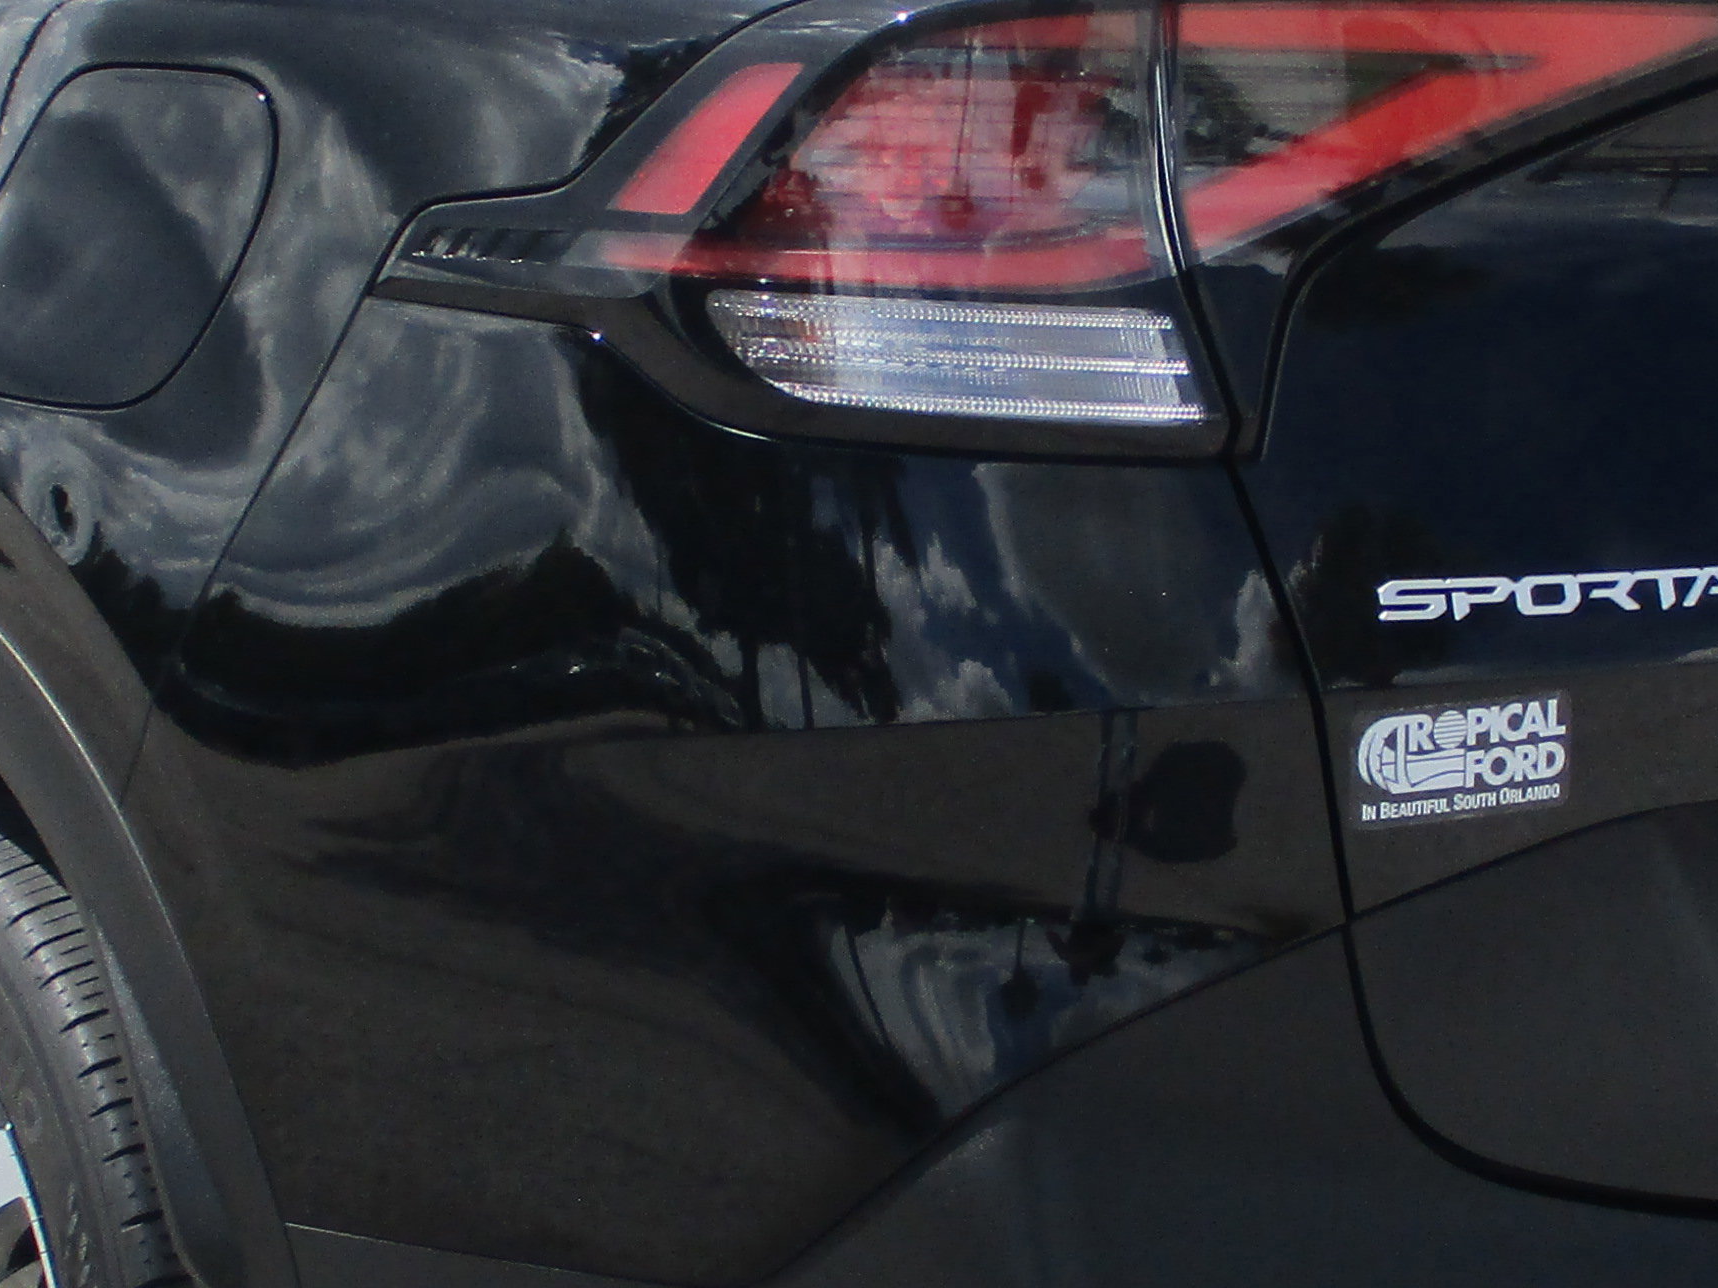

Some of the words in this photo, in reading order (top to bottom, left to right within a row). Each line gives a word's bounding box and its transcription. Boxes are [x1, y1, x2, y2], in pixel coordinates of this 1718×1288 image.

[1369, 698, 1567, 752] TROPICAL
[1464, 741, 1567, 789] FORD
[1362, 803, 1377, 821] IN
[1380, 797, 1450, 820] BEAUTIFUL
[1453, 791, 1498, 812] SOUTH
[1499, 782, 1561, 805] ORLANDO
